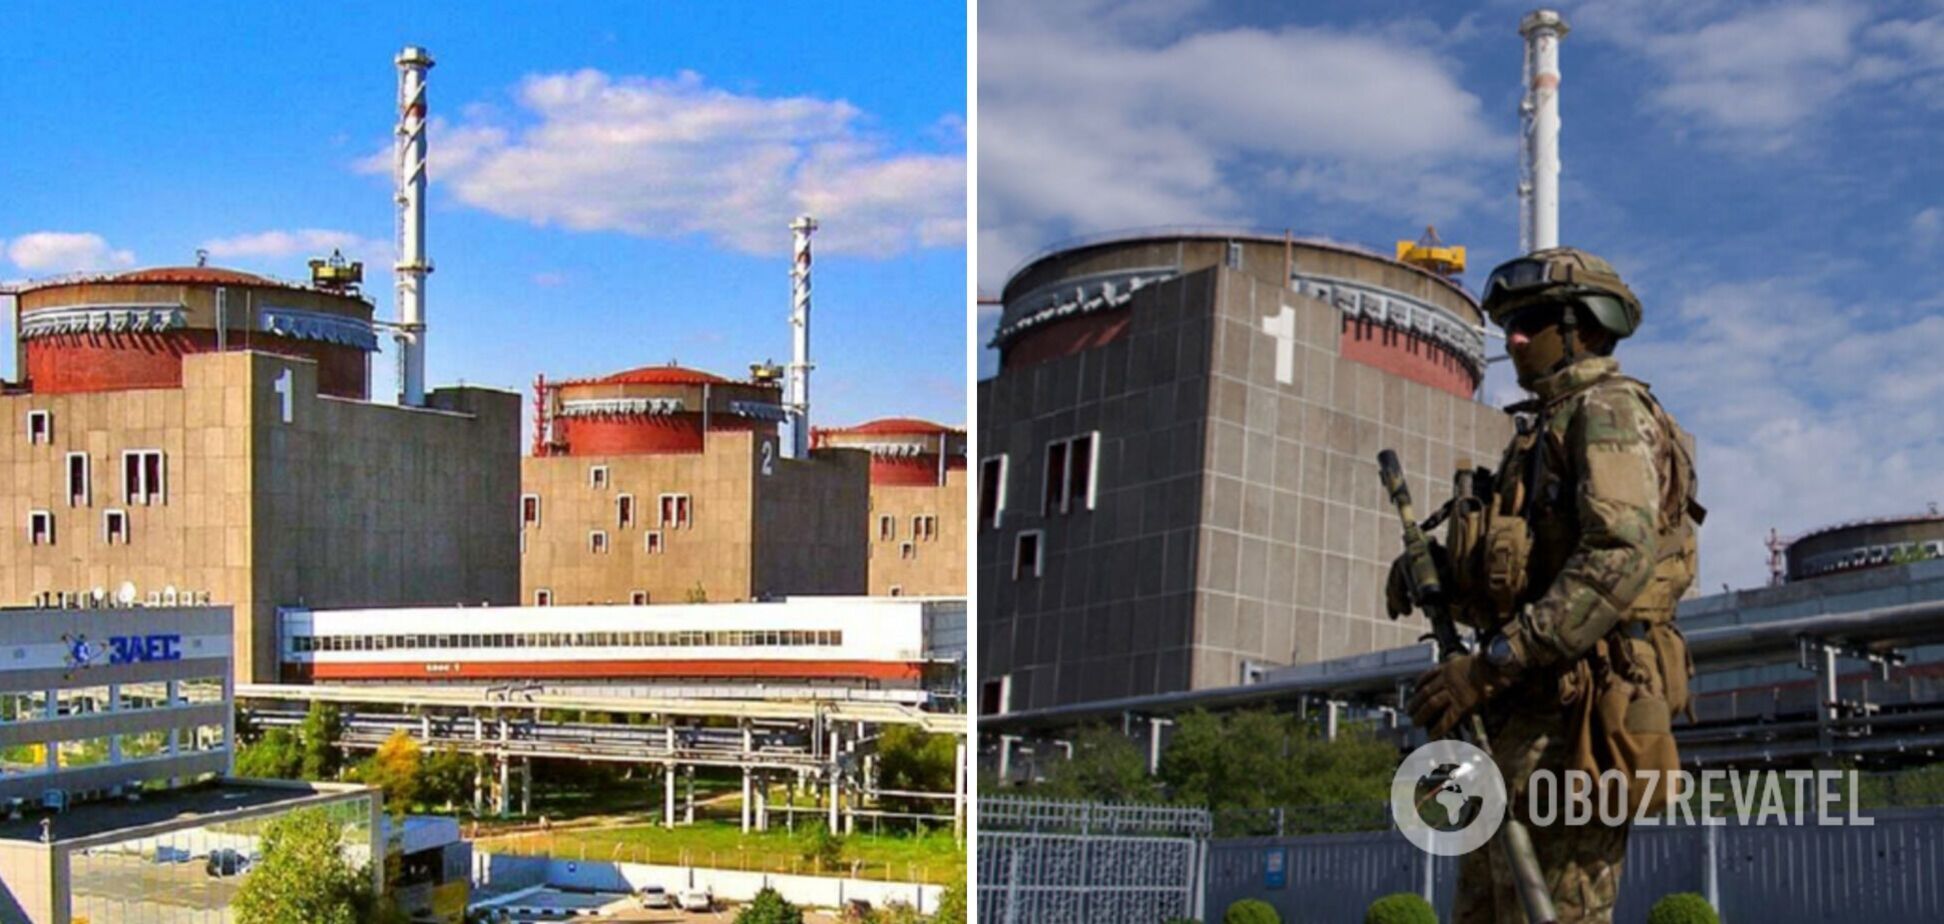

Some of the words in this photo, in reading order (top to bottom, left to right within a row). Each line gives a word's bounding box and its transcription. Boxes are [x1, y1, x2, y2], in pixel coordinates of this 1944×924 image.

[1262, 305, 1296, 385] 1
[275, 368, 292, 423] 1
[762, 440, 772, 475] 2
[109, 634, 181, 664] ЗАЕС
